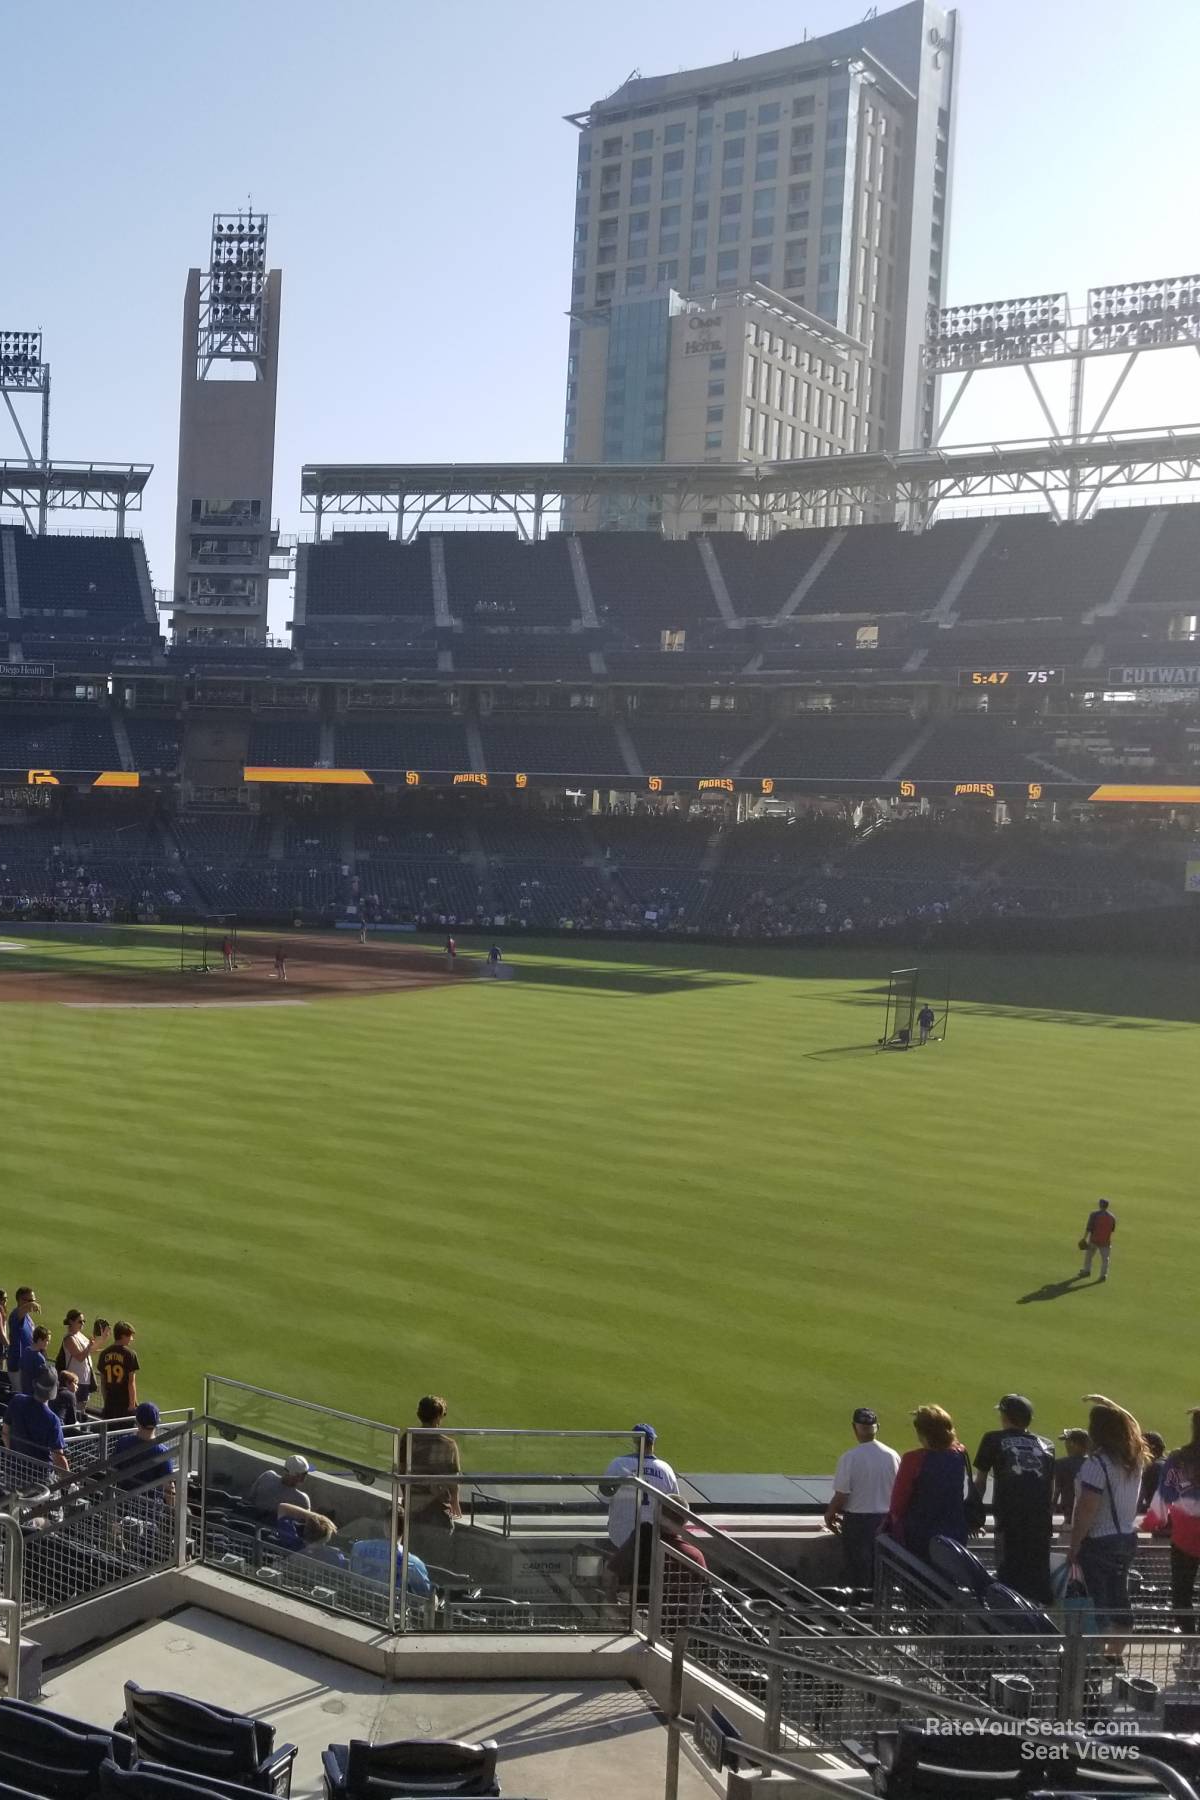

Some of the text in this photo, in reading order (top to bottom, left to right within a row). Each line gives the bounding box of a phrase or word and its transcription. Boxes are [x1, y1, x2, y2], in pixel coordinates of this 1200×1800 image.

[0, 664, 20, 675] Diego
[20, 665, 45, 675] Health
[1122, 668, 1200, 683] CUTWAT
[972, 672, 1009, 684] 5:47
[453, 773, 488, 786] PADRES
[698, 778, 734, 792] PADRES
[955, 783, 995, 797] PADRES
[104, 1364, 125, 1384] 19
